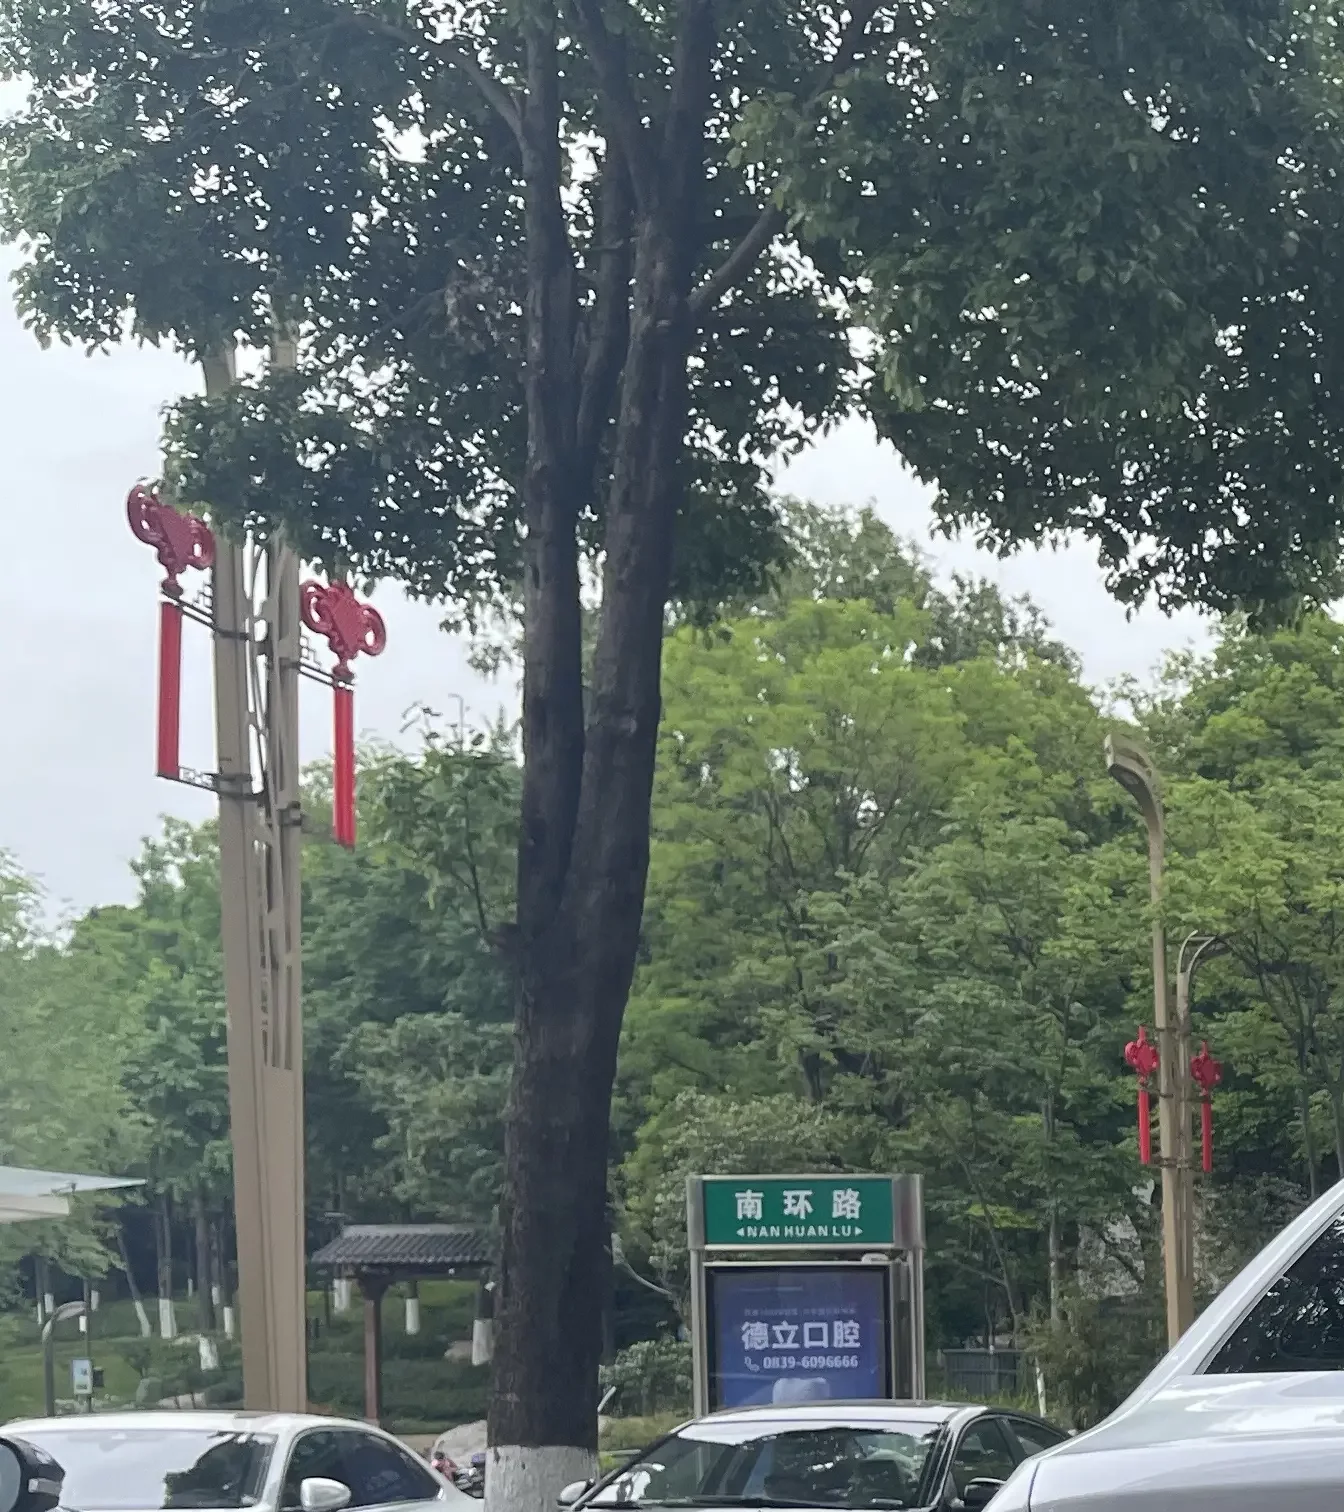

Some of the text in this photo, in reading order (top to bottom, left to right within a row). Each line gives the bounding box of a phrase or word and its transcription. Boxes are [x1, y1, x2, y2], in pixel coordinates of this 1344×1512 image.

[735, 1188, 861, 1220] 南环路
[747, 1225, 851, 1238] NAN HUAN LU
[741, 1320, 861, 1350] 德立口腔
